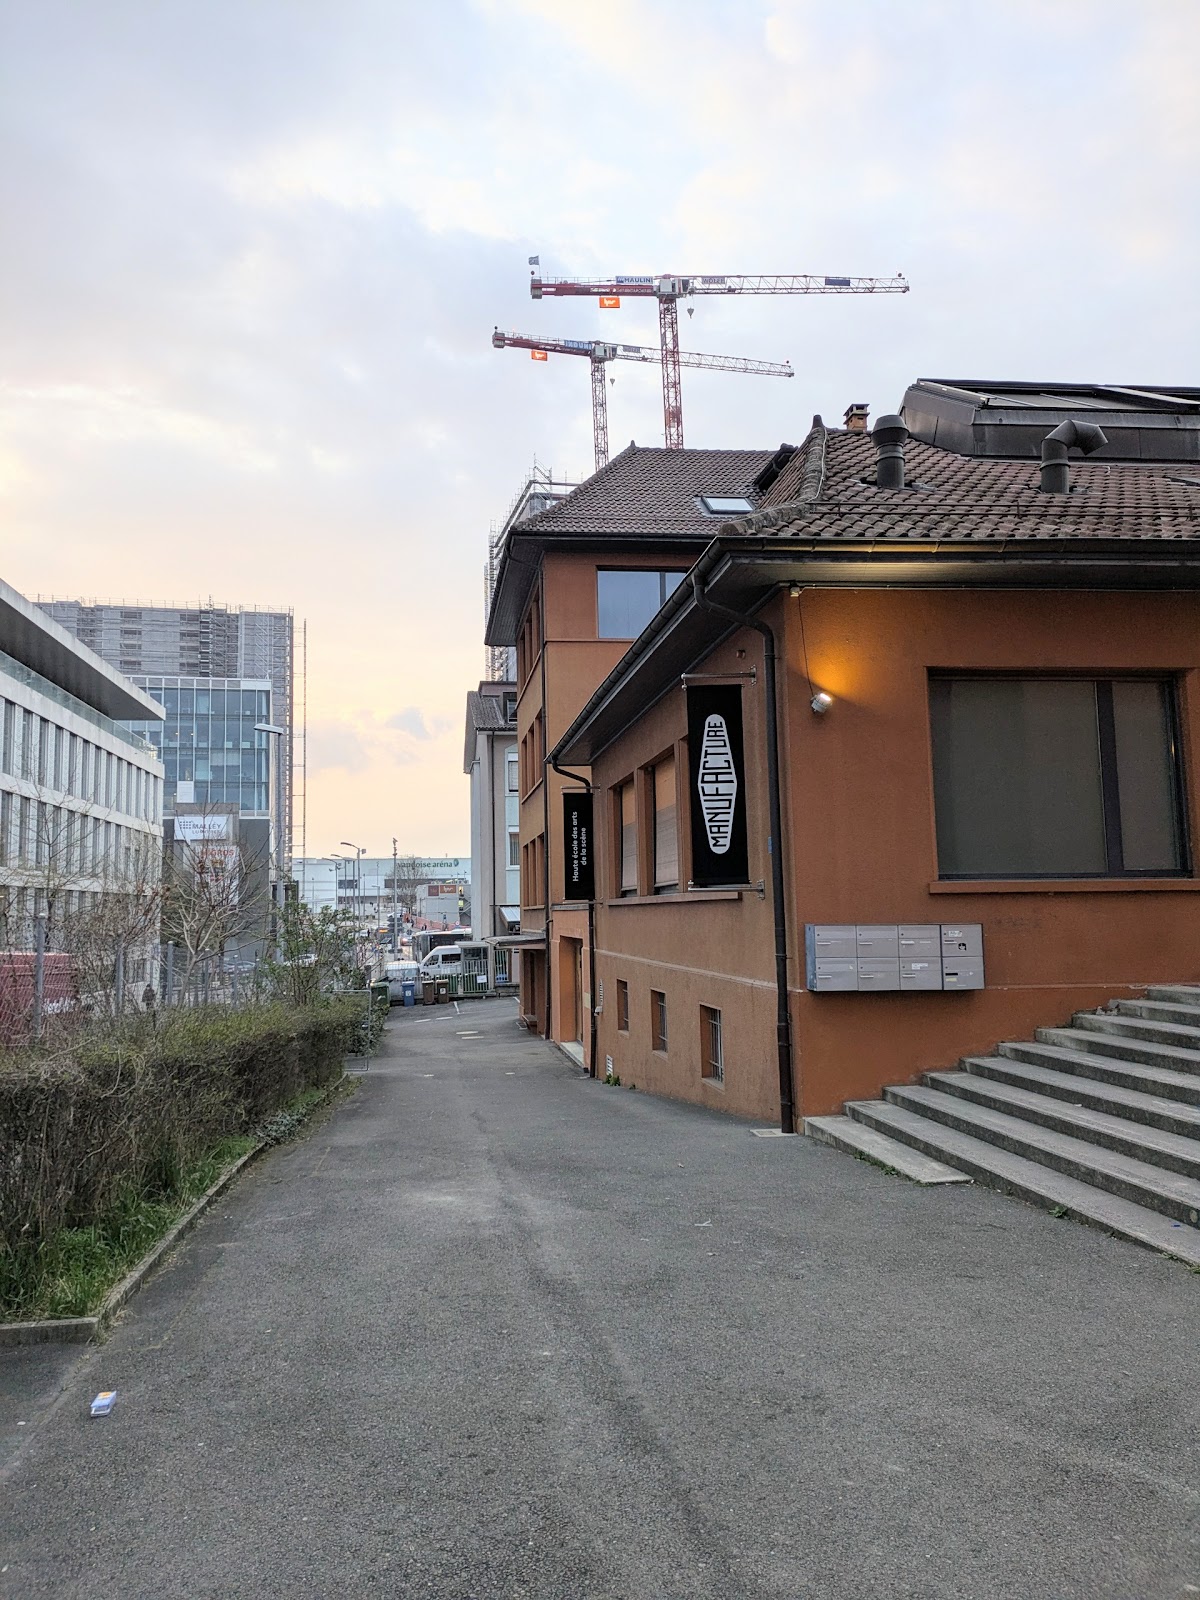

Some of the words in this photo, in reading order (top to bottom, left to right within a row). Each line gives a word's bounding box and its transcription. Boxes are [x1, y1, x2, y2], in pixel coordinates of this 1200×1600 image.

[700, 721, 734, 848] MANUFACTURE
[571, 839, 579, 859] école
[580, 848, 587, 856] la
[580, 856, 587, 866] de
